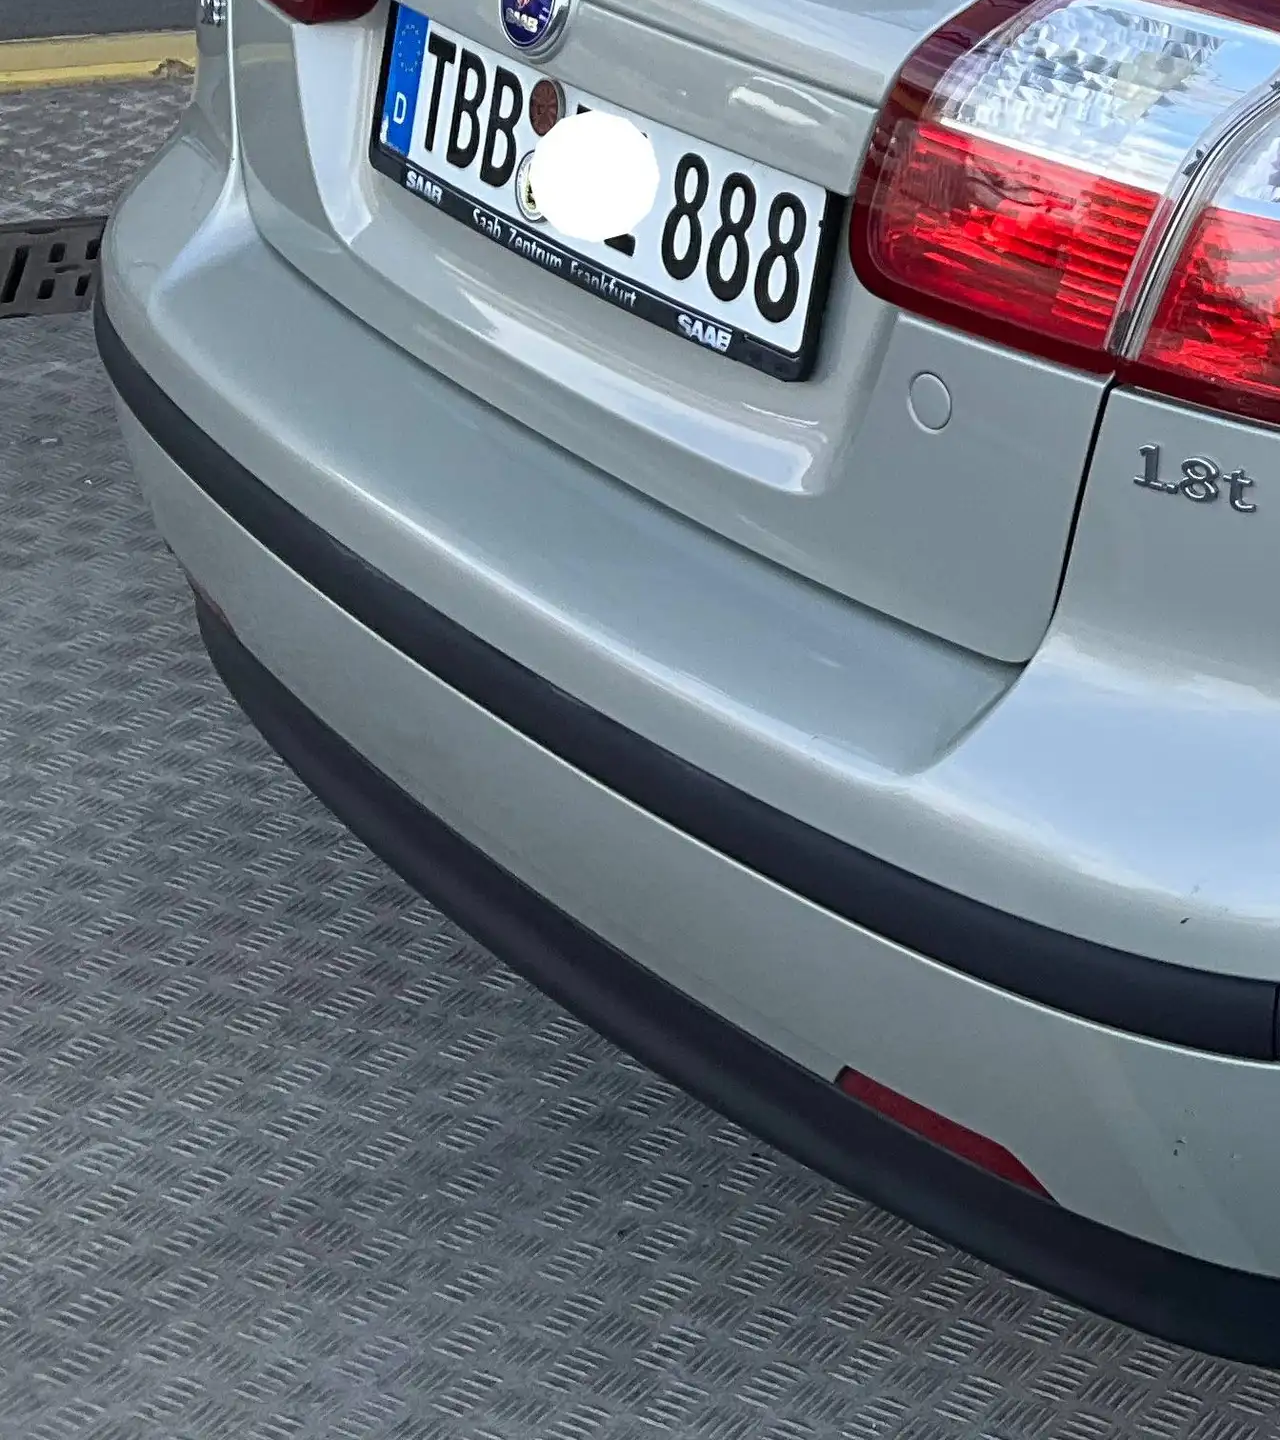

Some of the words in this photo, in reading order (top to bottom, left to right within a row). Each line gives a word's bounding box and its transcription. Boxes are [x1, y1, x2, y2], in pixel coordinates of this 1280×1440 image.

[393, 91, 407, 124] D
[424, 31, 523, 188] TBB
[661, 152, 807, 324] 888
[406, 170, 443, 205] SAAB
[473, 208, 501, 239] Saab
[508, 227, 563, 268] Zentrum
[569, 260, 637, 307] Frankfurt
[677, 313, 732, 352] SAAB
[1133, 443, 1257, 513] 1.8t
